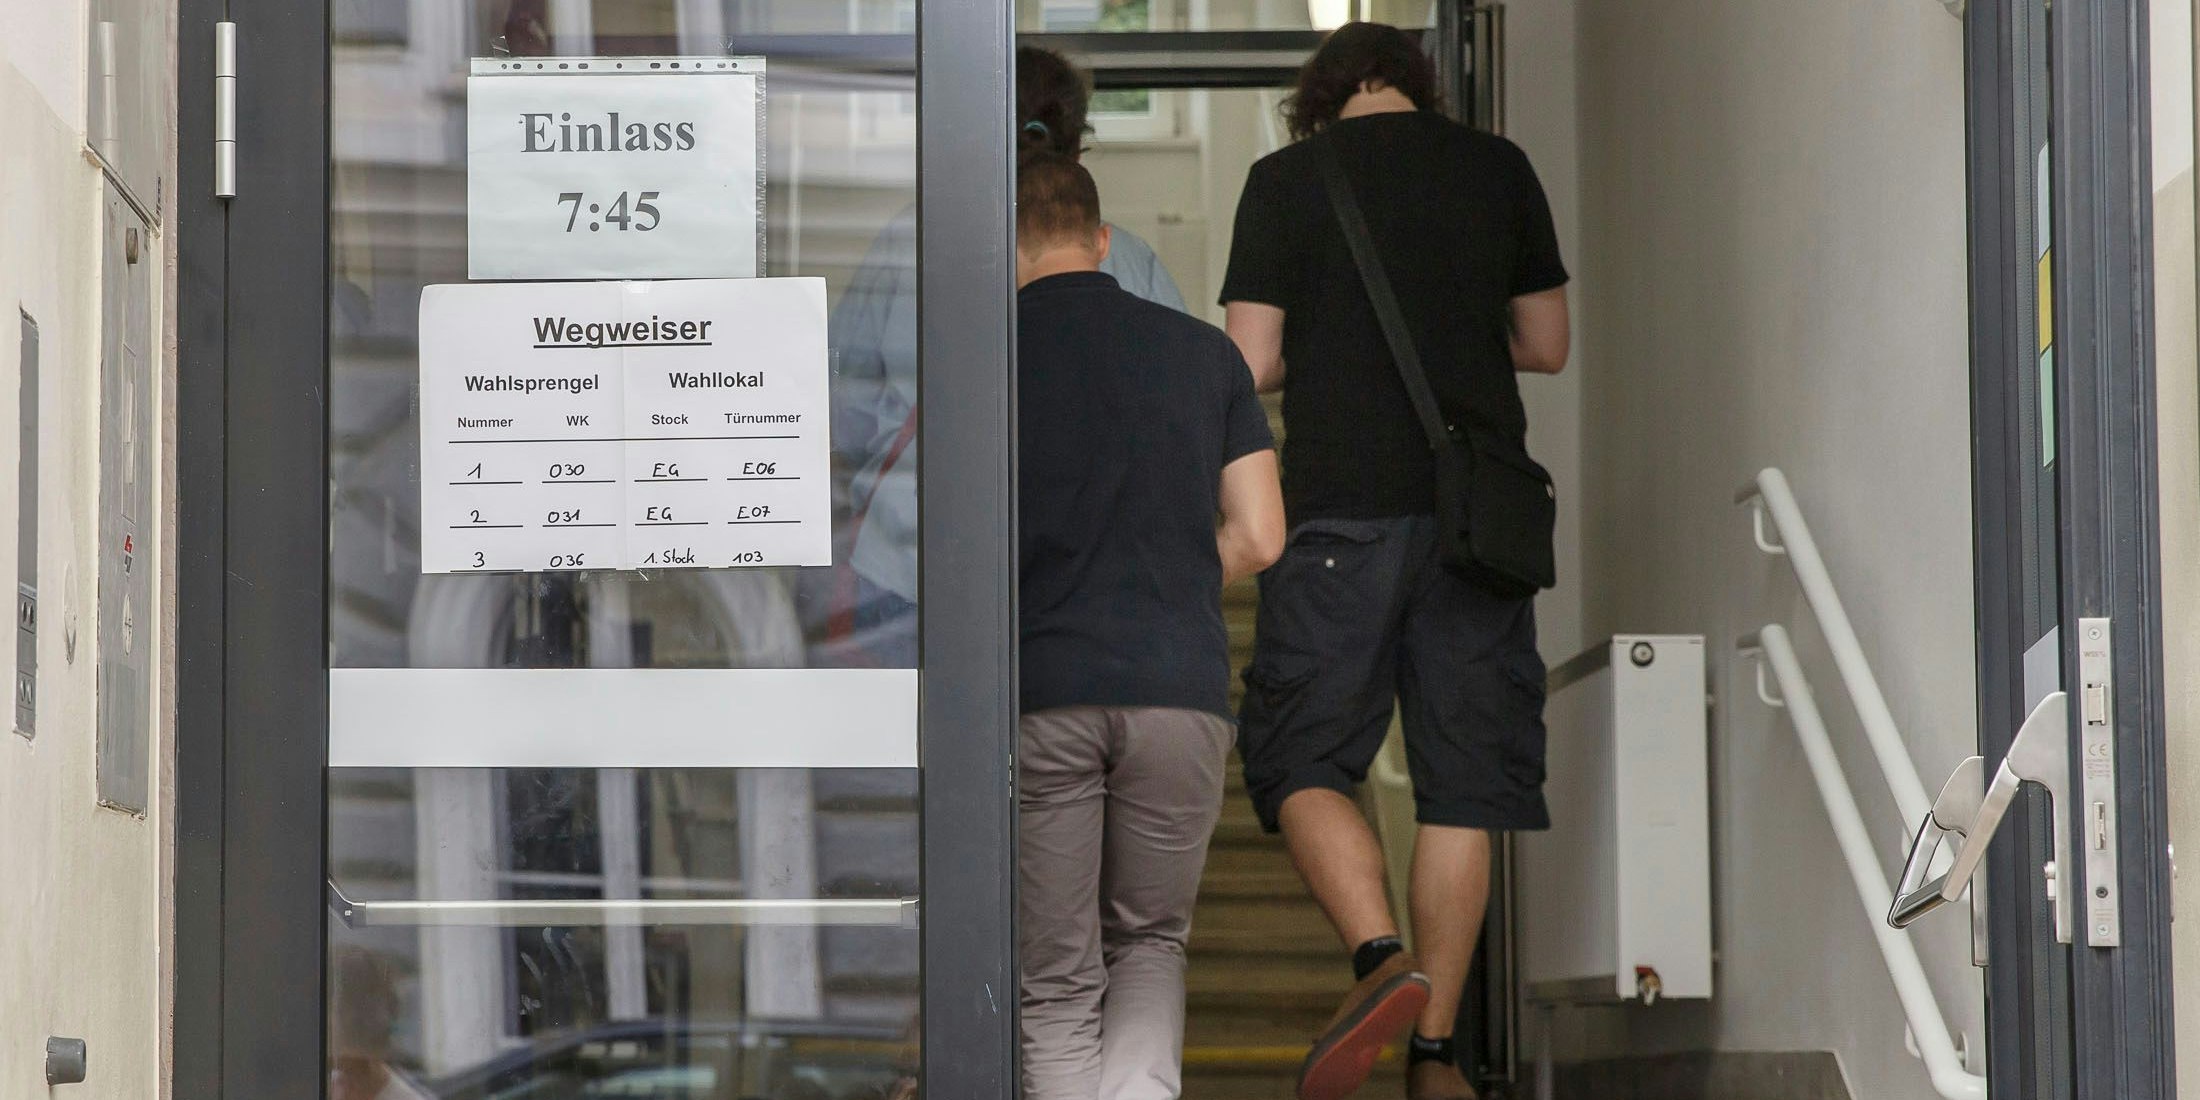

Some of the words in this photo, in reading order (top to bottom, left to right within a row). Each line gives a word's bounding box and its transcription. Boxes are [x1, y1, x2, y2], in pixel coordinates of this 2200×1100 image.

[520, 112, 696, 153] Einlass
[557, 191, 661, 233] 7:45
[532, 314, 713, 349] Wegweiser
[464, 373, 600, 395] Wahlsprengel
[668, 371, 765, 389] Wahllokal
[457, 416, 514, 429] Nummer
[565, 415, 590, 427] WK
[651, 413, 689, 425] Stock
[723, 411, 802, 424] Türnummer
[467, 462, 482, 479] 1
[549, 463, 585, 478] 030
[652, 462, 680, 478] EG
[742, 462, 777, 476] E06
[470, 509, 488, 524] 2
[547, 509, 581, 524] 031
[646, 506, 673, 522] EG
[736, 505, 771, 520] E07
[472, 551, 485, 568] 3
[549, 552, 585, 568] 036
[643, 552, 658, 564] 1.
[662, 547, 696, 564] Stock
[732, 550, 764, 564] 103
